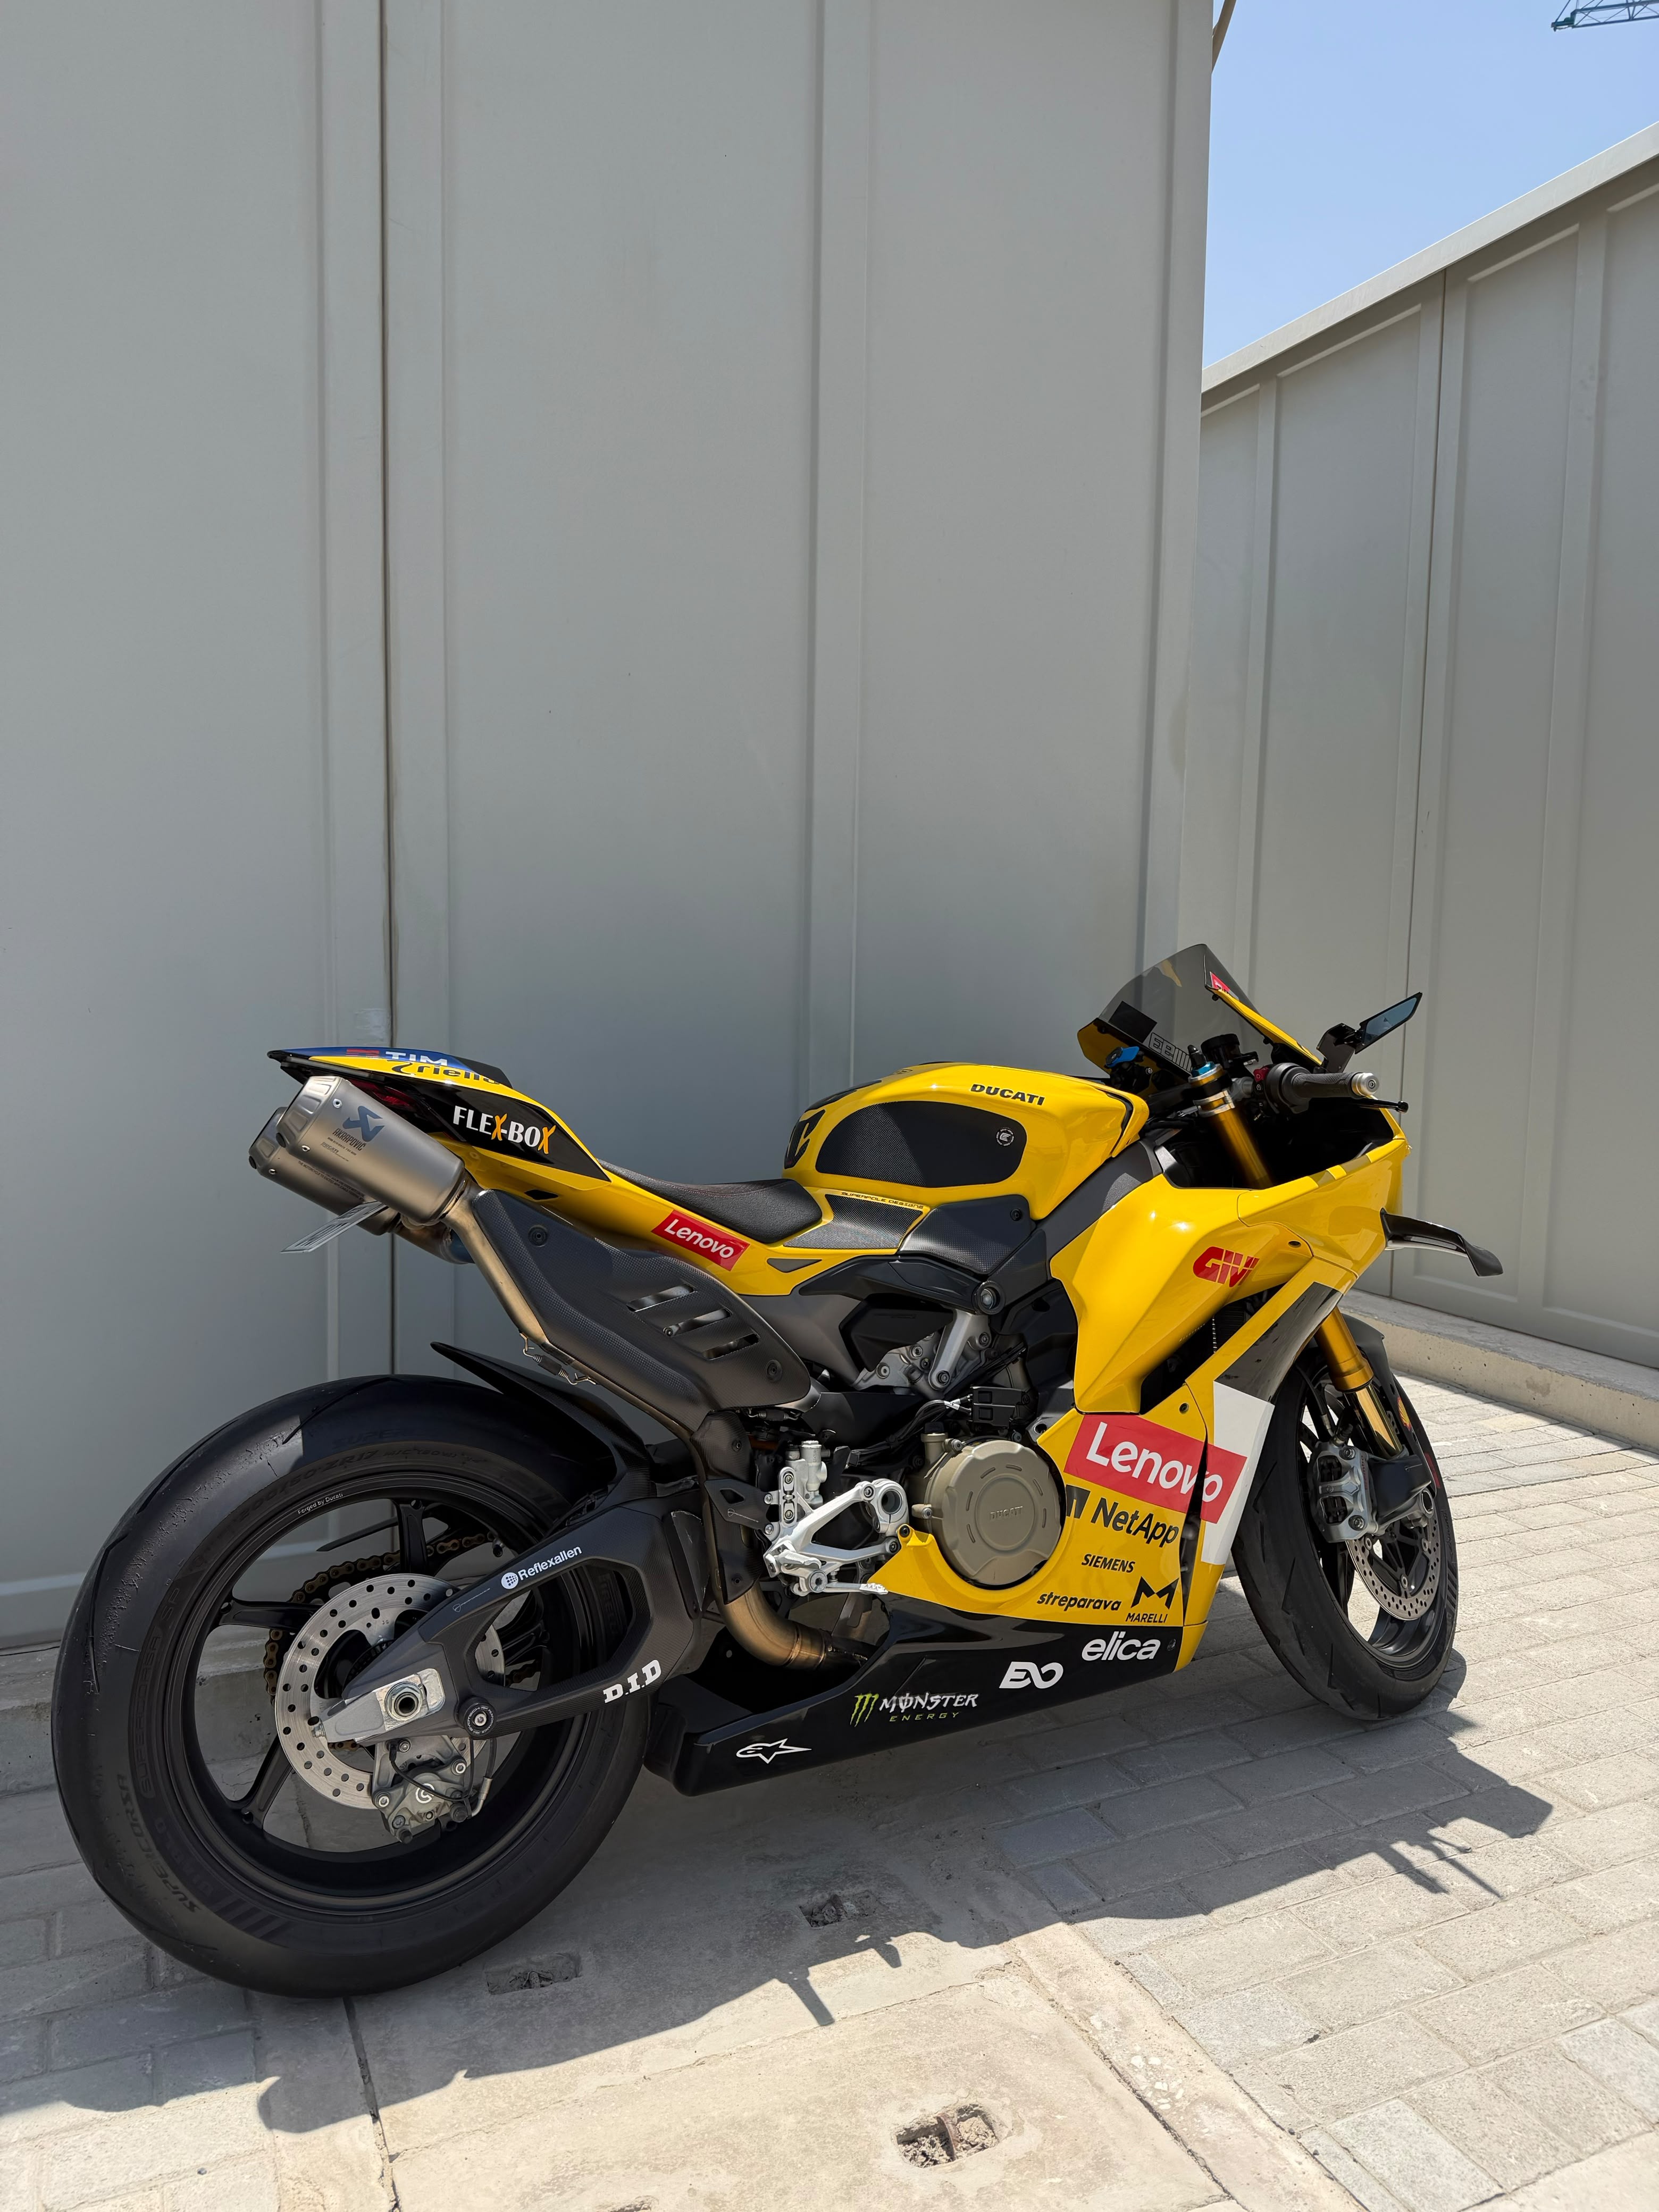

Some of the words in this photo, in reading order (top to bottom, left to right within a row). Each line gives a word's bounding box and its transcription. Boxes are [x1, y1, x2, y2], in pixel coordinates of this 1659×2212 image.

[386, 1051, 448, 1066] TIM
[970, 1084, 1045, 1106] DUCATI
[453, 1105, 556, 1154] FLEX-BOX
[664, 1218, 734, 1259] Lenovo
[1086, 1422, 1222, 1502] Lenovo
[298, 1502, 317, 1514] Forged
[325, 1493, 343, 1502] Ducati
[1091, 1497, 1179, 1548] NetApp
[517, 1546, 582, 1581] Reflexallen
[1082, 1553, 1135, 1573] SIEMENS
[1037, 1591, 1121, 1612] streparava
[1125, 1612, 1168, 1623] MARELLI
[1082, 1631, 1161, 1661] elica
[603, 1660, 661, 1703] D.I.D
[879, 1692, 979, 1713] MONSTER
[889, 1712, 959, 1722] ENERGY
